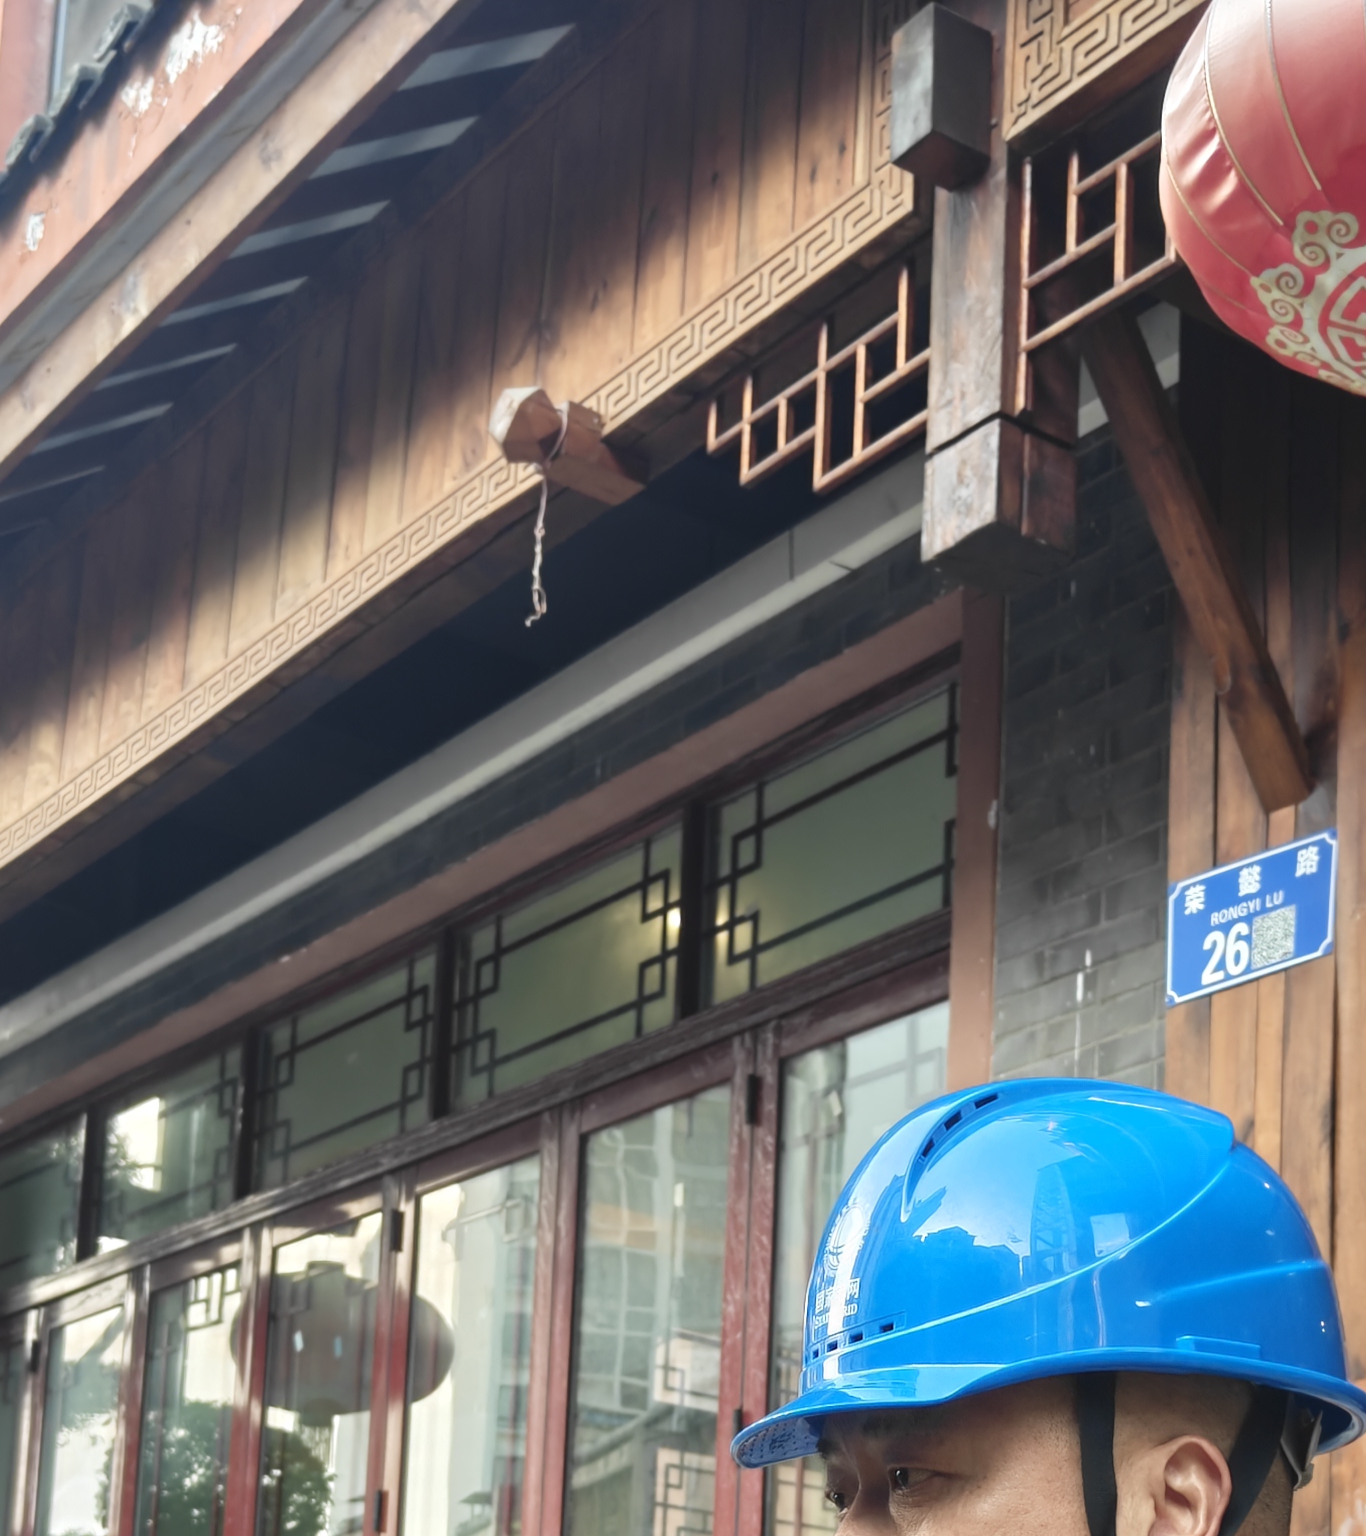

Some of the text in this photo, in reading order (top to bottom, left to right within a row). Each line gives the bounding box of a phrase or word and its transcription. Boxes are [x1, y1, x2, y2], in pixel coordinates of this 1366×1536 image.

[1210, 890, 1284, 926] RONGYI LU
[1201, 922, 1250, 985] 26
